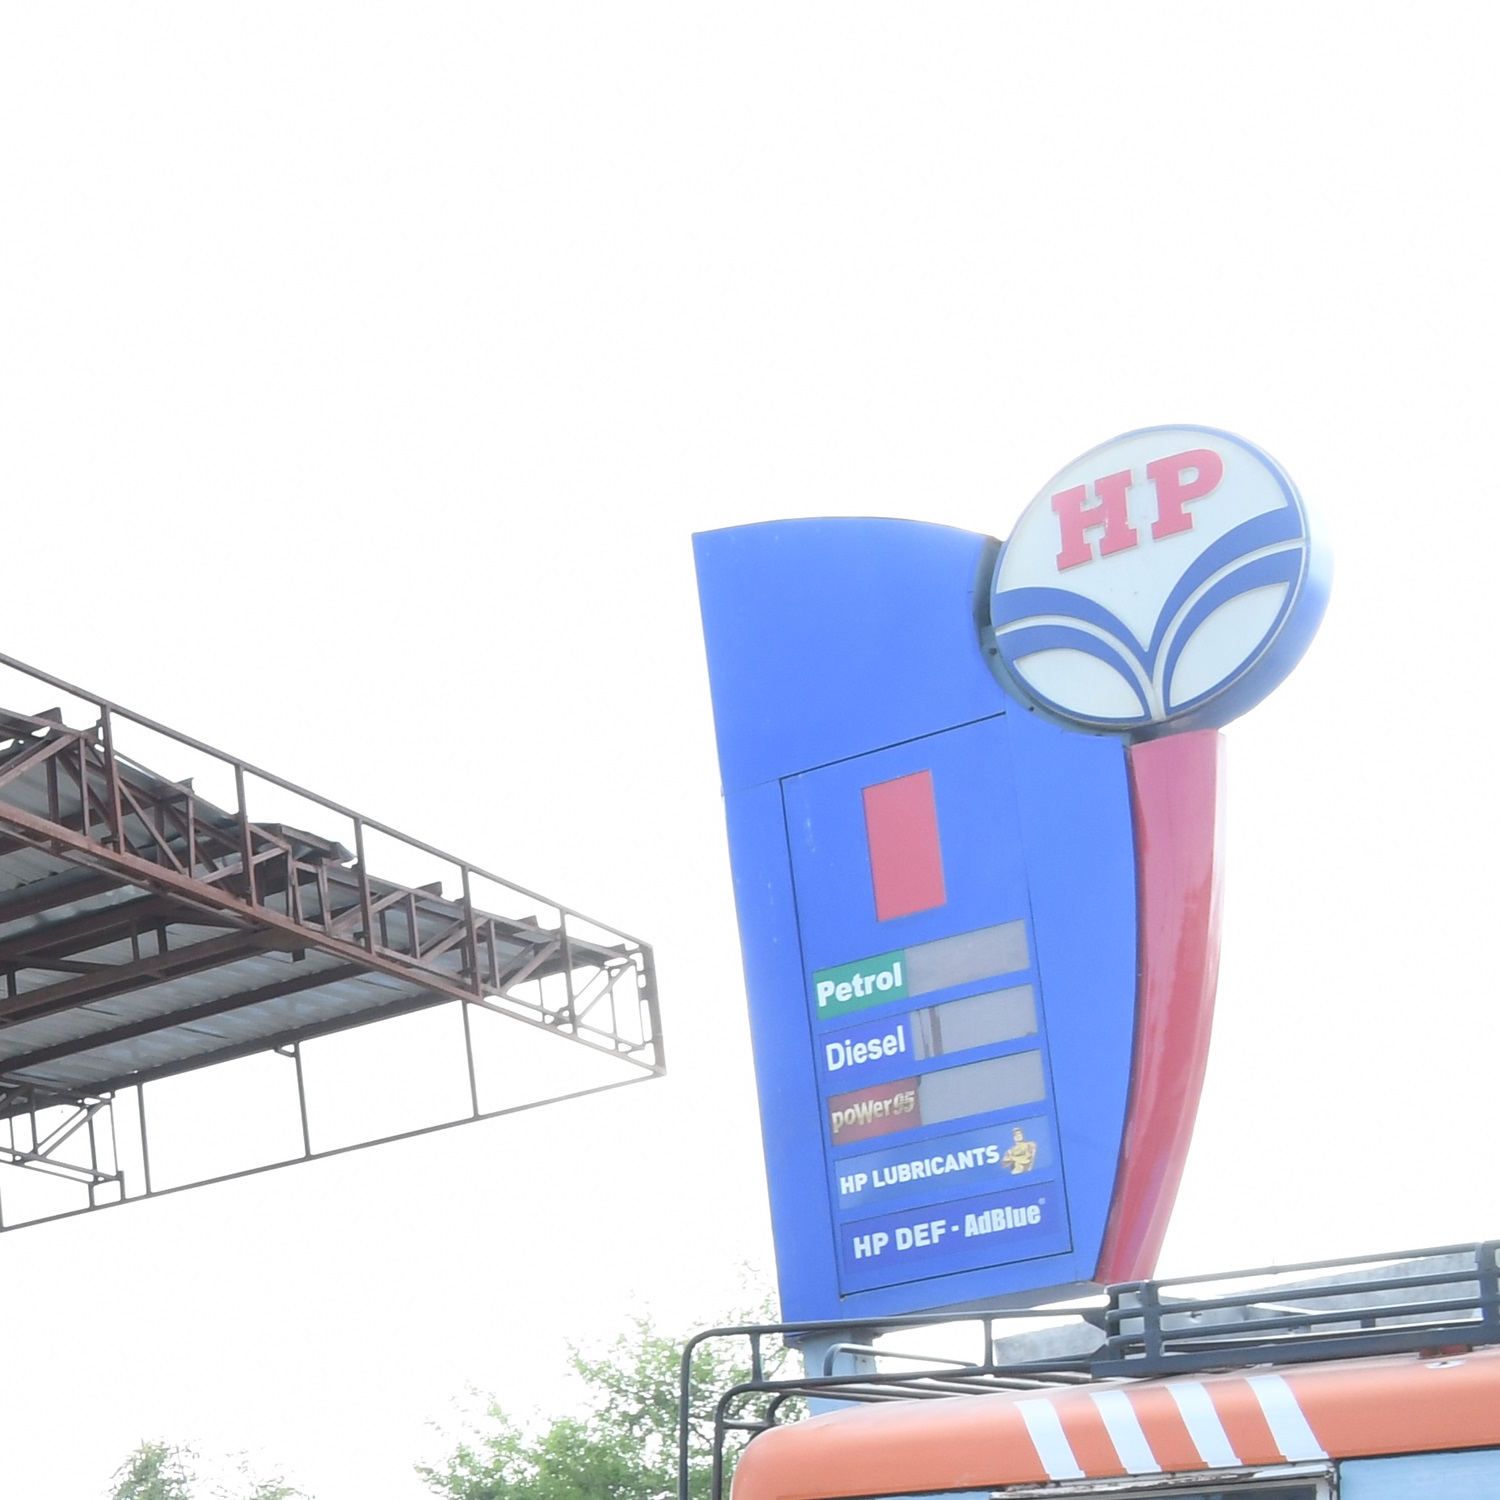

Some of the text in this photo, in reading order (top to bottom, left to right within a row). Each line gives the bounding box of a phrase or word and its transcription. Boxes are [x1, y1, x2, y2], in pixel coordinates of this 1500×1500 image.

[1051, 448, 1224, 572] HP
[816, 961, 903, 1007] Petrol
[825, 1024, 906, 1071] Diesel
[839, 1144, 1000, 1194] HP LUBRICANTS
[852, 1231, 889, 1259] HP
[895, 1219, 947, 1252] DEF
